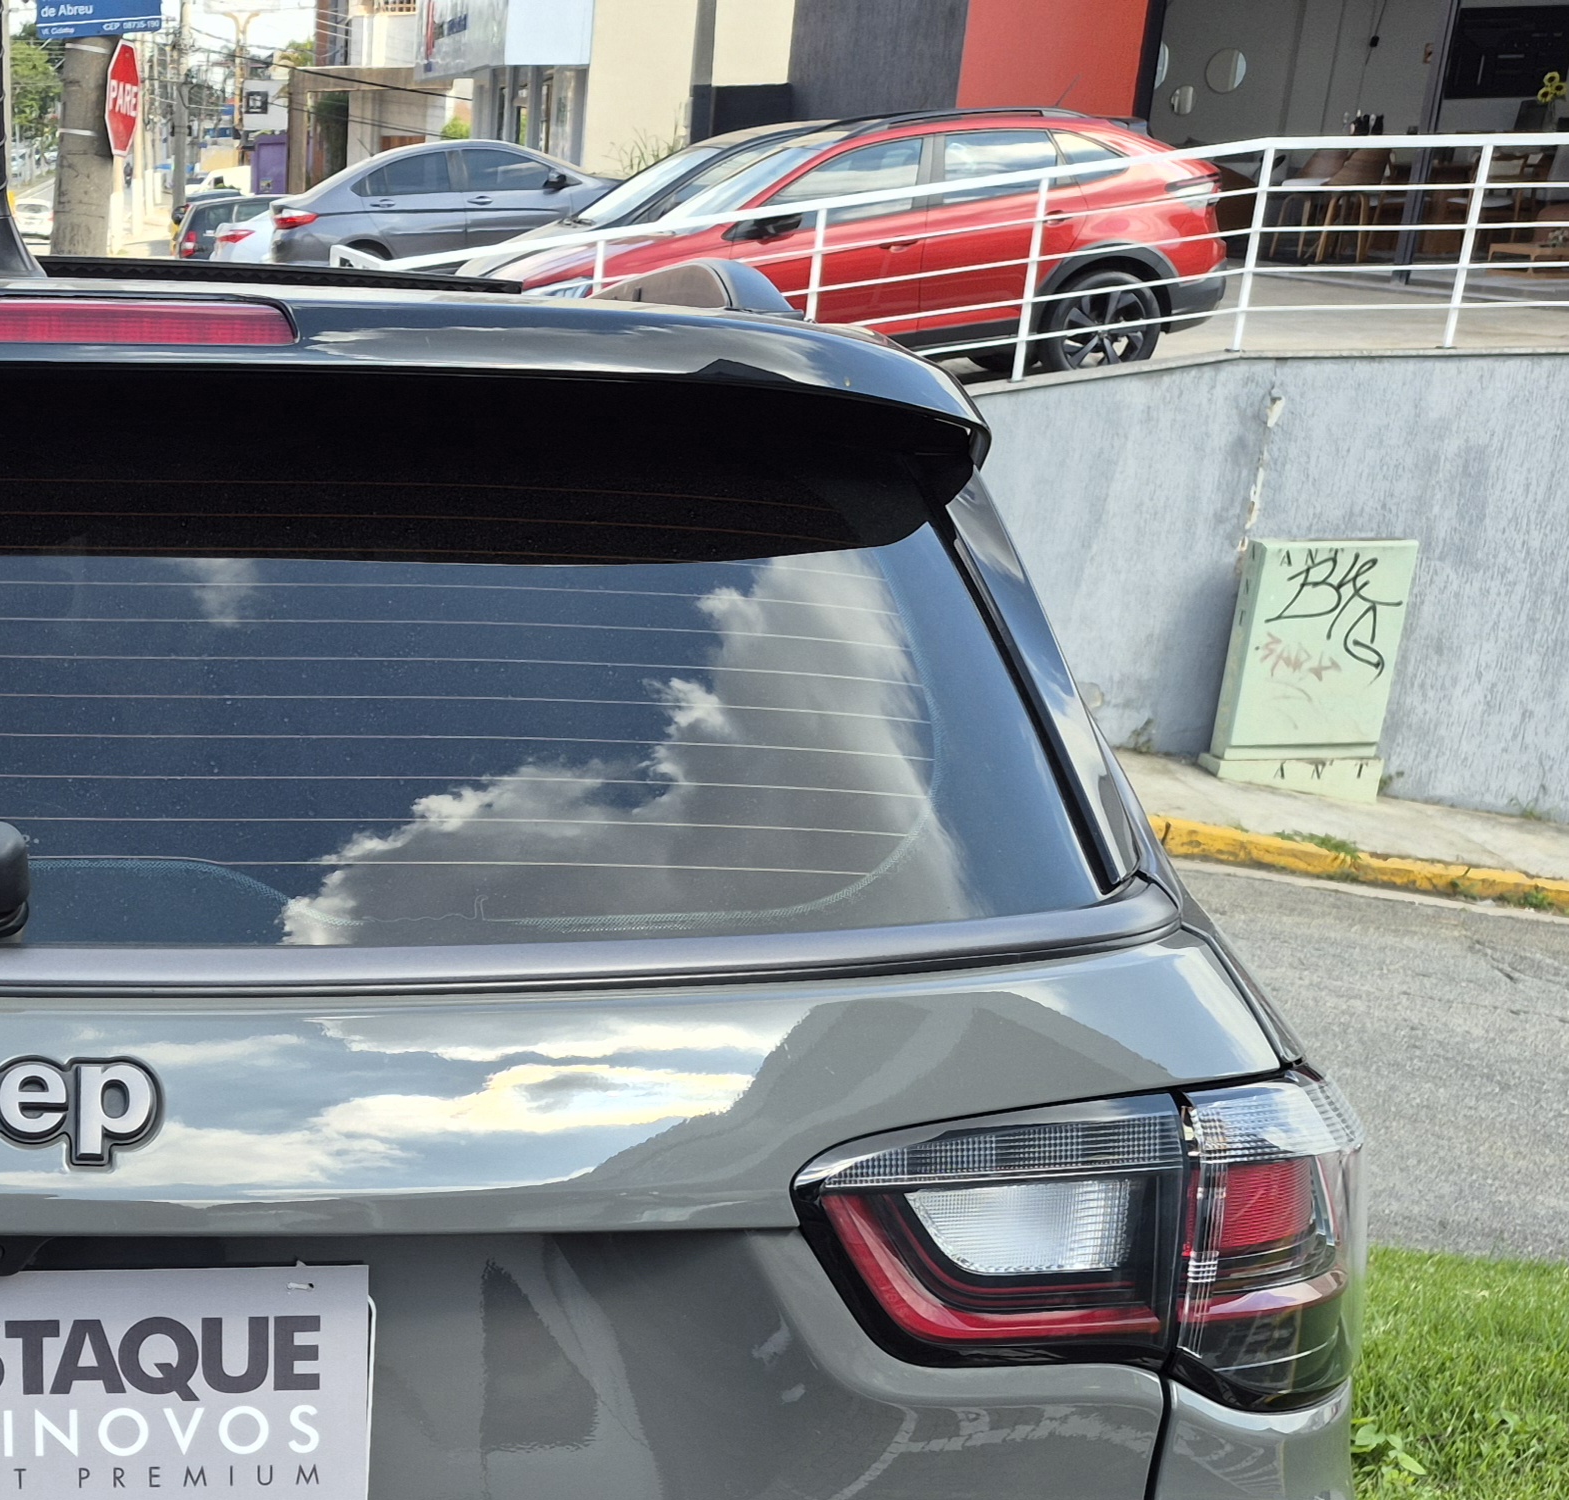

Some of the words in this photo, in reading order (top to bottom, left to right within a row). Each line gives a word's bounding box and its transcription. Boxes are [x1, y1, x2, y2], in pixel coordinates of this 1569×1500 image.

[41, 6, 56, 17] de
[58, 5, 93, 16] Abreu
[109, 79, 139, 118] PARE
[78, 1463, 321, 1489] PREMIUM
